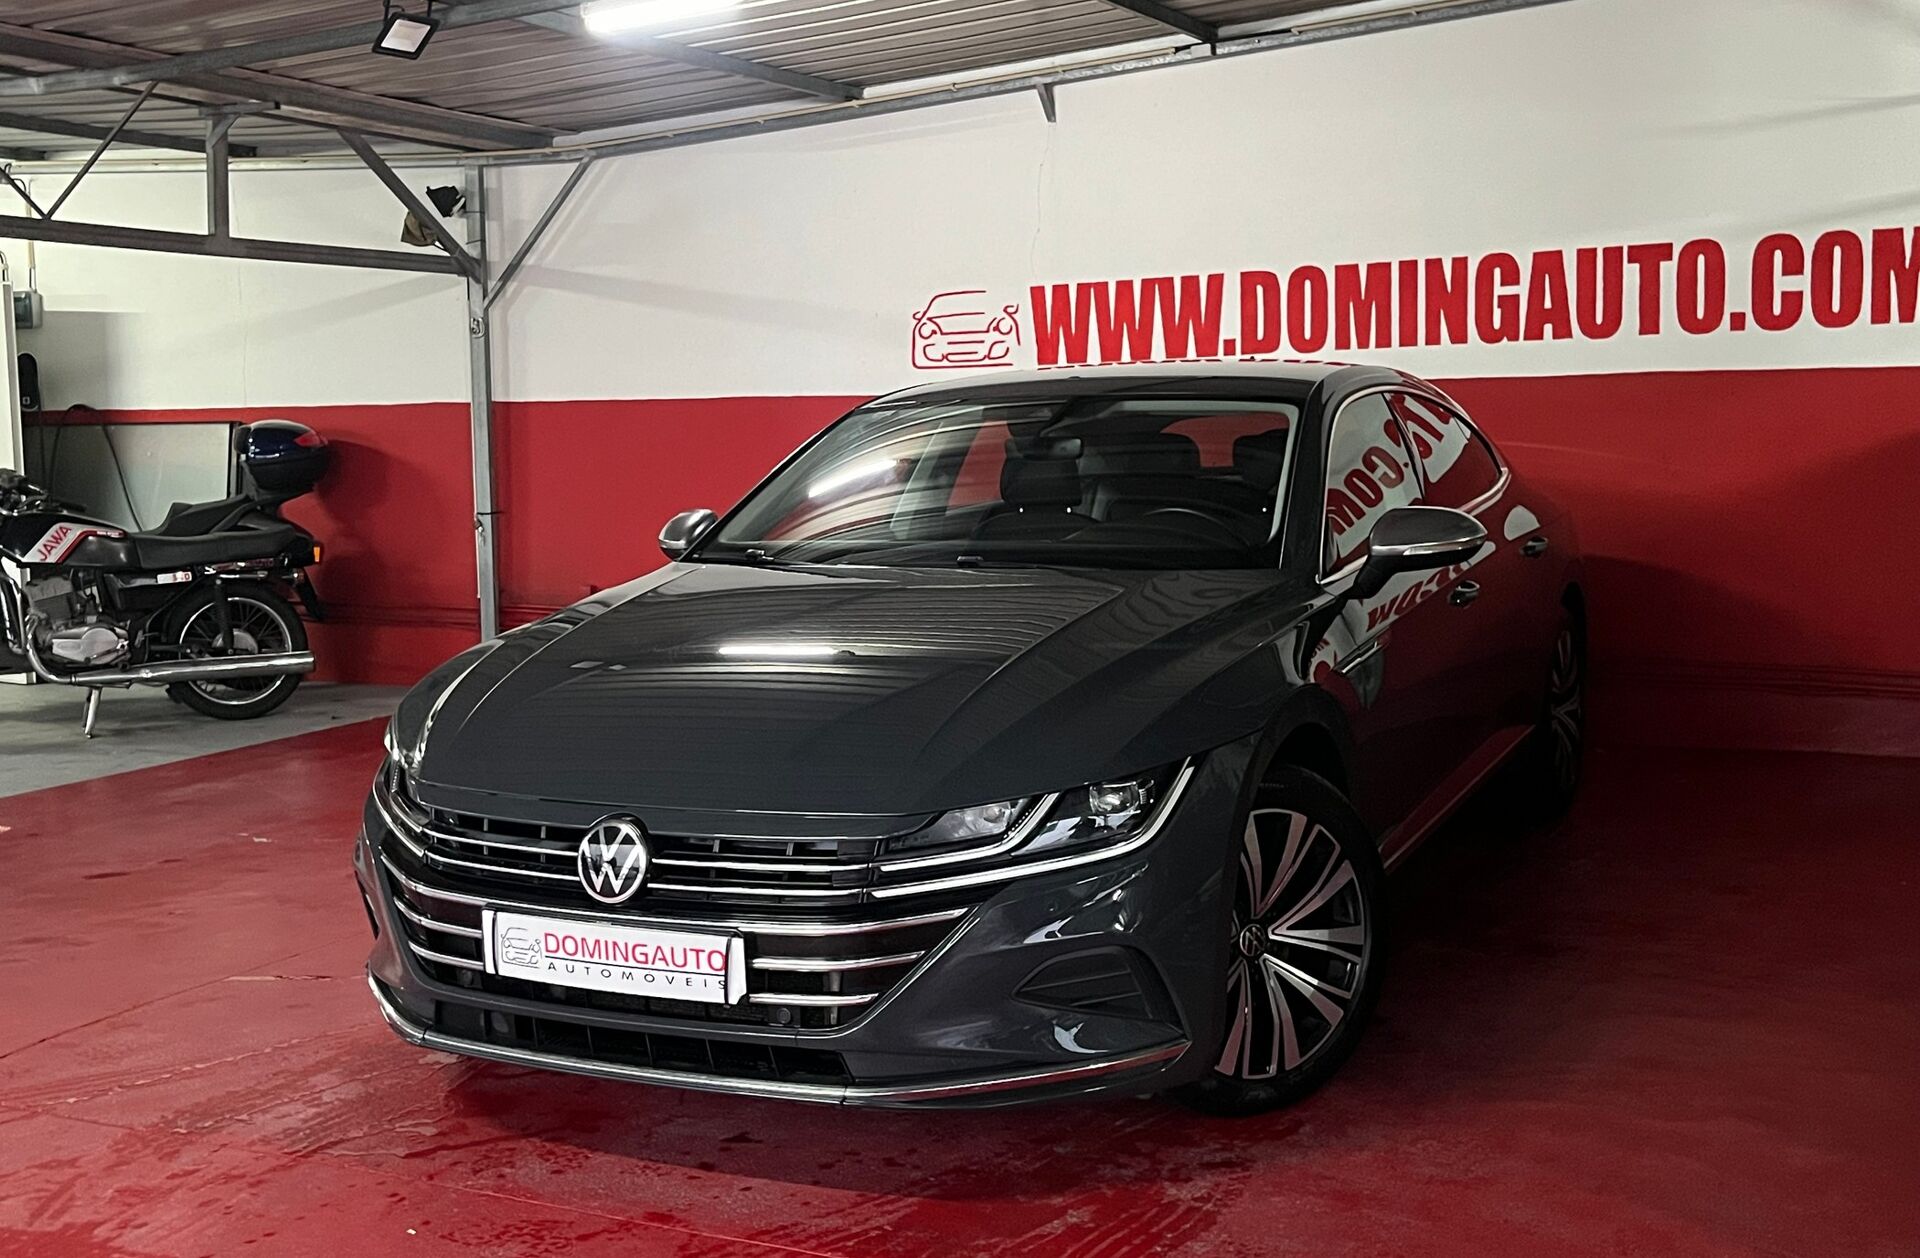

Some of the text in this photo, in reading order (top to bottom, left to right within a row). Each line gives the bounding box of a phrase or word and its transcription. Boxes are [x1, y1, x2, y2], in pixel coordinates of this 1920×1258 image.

[1030, 226, 1920, 366] WWW.DOMINGAUTO.COM
[37, 525, 73, 562] JAWA
[544, 932, 726, 973] DOMINGAUTO
